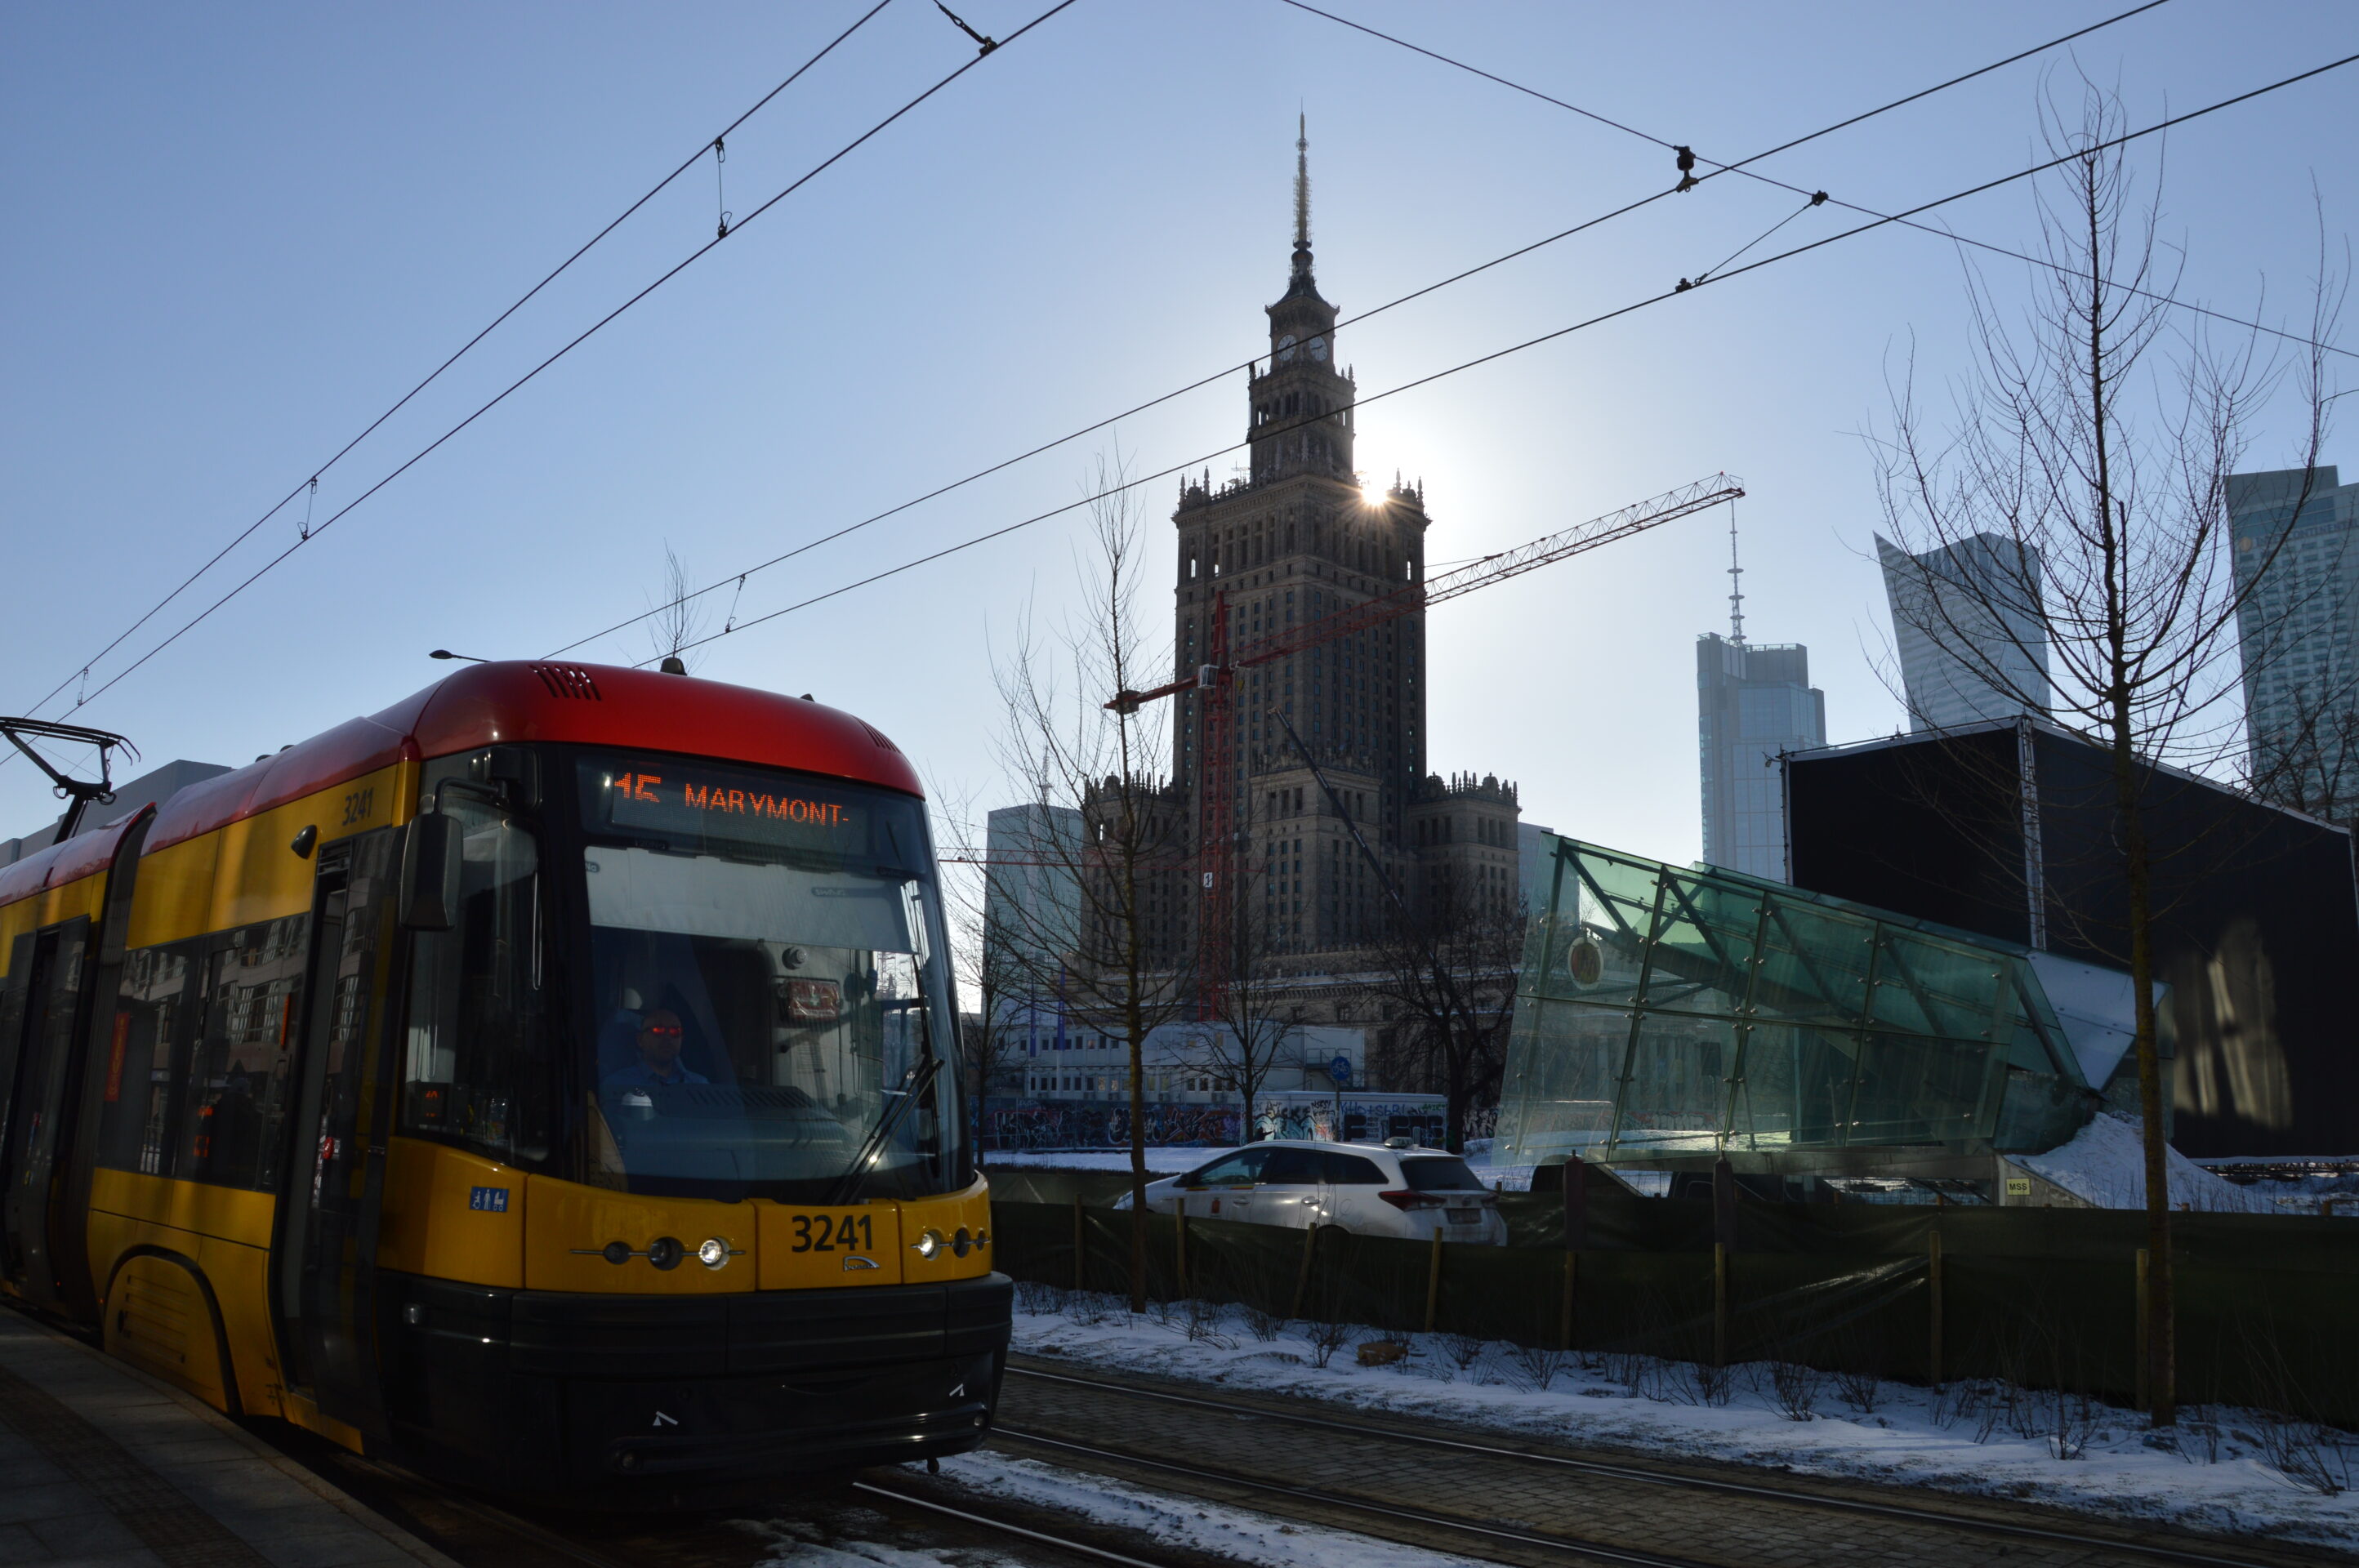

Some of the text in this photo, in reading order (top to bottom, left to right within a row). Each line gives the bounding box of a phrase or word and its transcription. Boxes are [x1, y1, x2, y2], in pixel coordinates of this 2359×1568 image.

[342, 786, 374, 826] 3241
[2009, 1183, 2027, 1191] MSS
[791, 1214, 872, 1253] 3241
